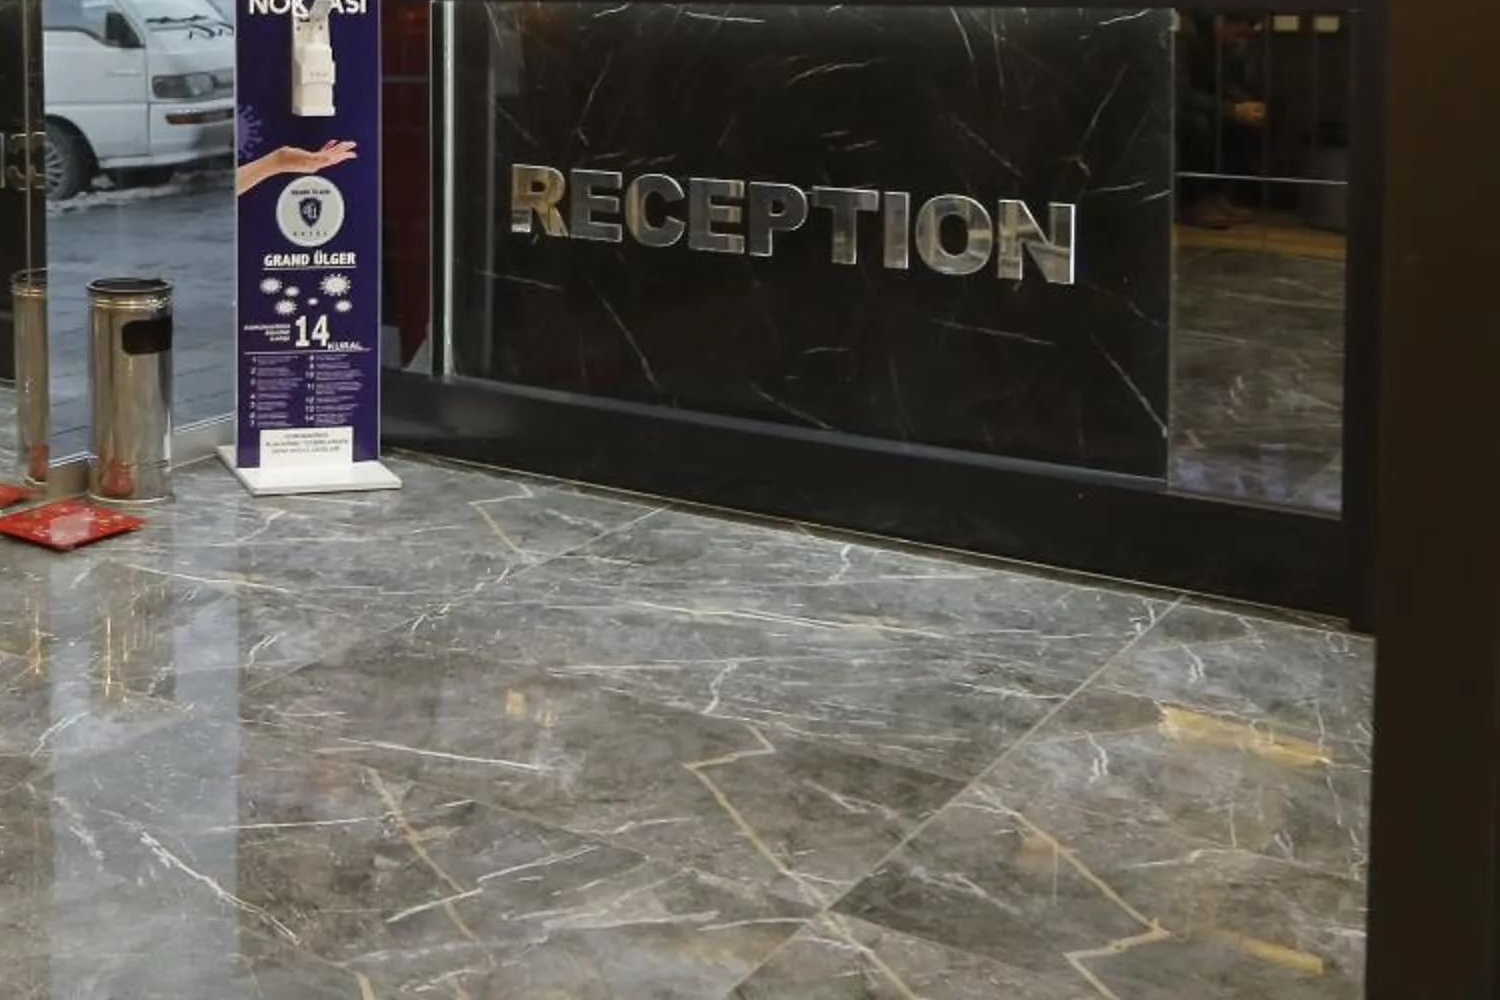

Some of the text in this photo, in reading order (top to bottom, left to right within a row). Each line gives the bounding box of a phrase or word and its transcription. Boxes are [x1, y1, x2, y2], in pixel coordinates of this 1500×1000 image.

[509, 162, 1078, 286] RECEPTION
[263, 249, 357, 267] GRAND ÜLGER
[295, 315, 331, 348] 14
